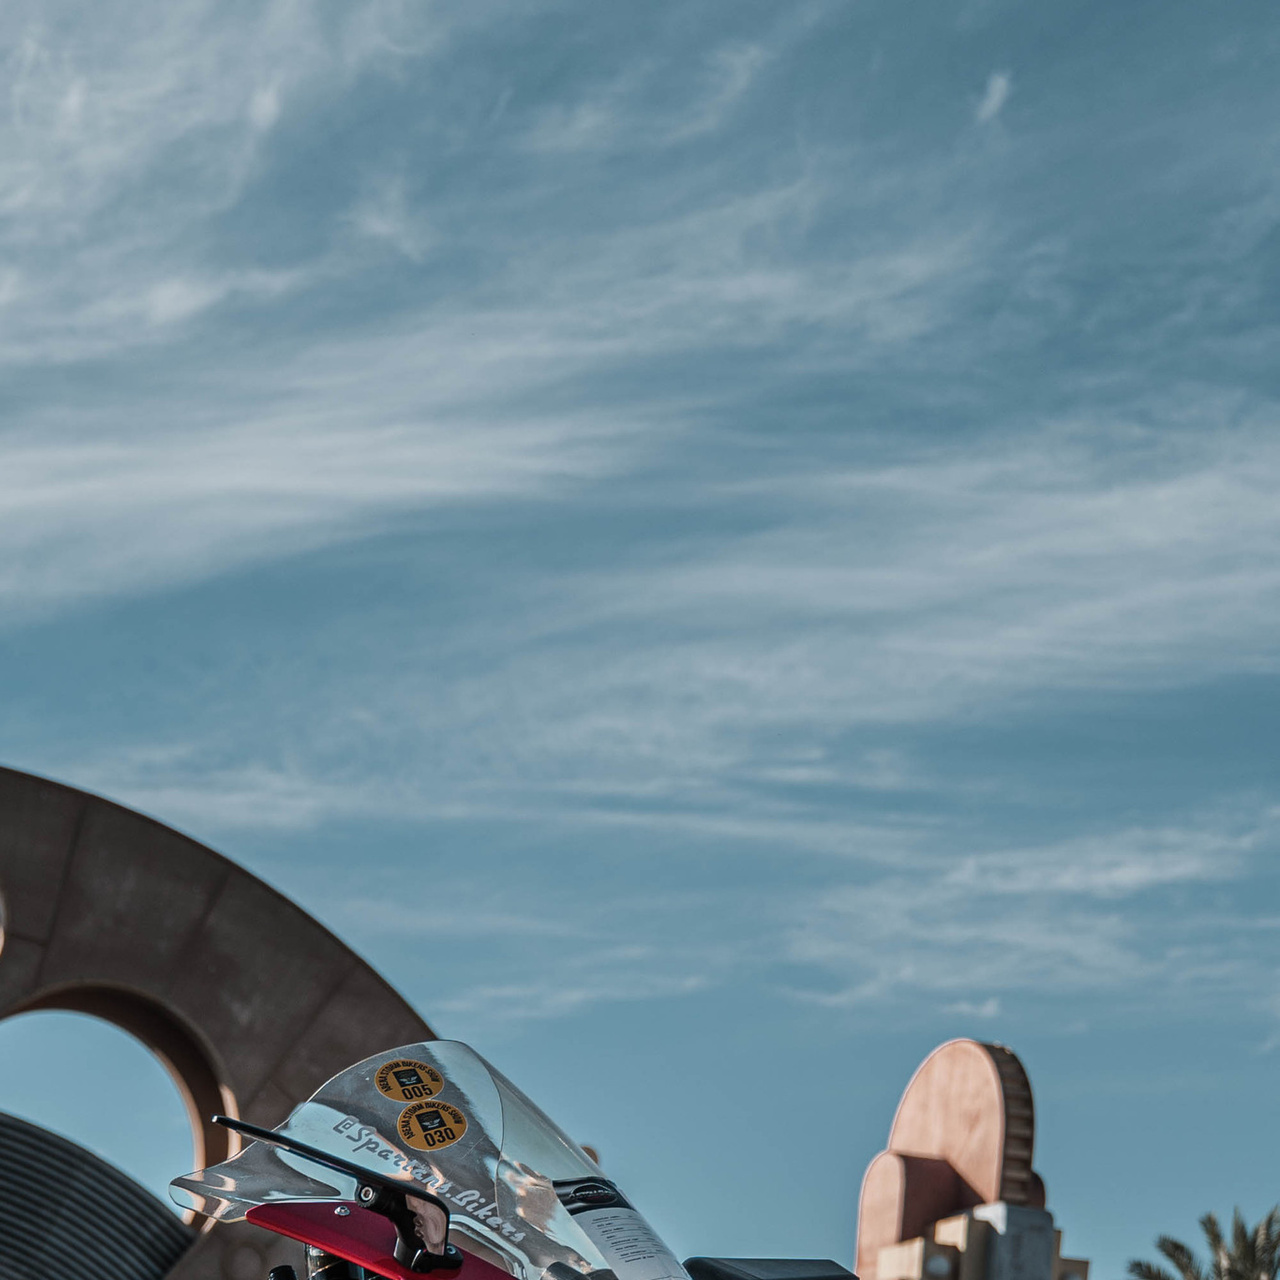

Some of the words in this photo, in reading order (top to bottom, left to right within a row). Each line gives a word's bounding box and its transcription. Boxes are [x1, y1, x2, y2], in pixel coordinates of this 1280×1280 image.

[401, 1060, 427, 1072] BIKERS
[401, 1084, 433, 1100] 005
[403, 1103, 425, 1119] STORM
[425, 1102, 451, 1113] BIKERS
[424, 1127, 456, 1147] 030
